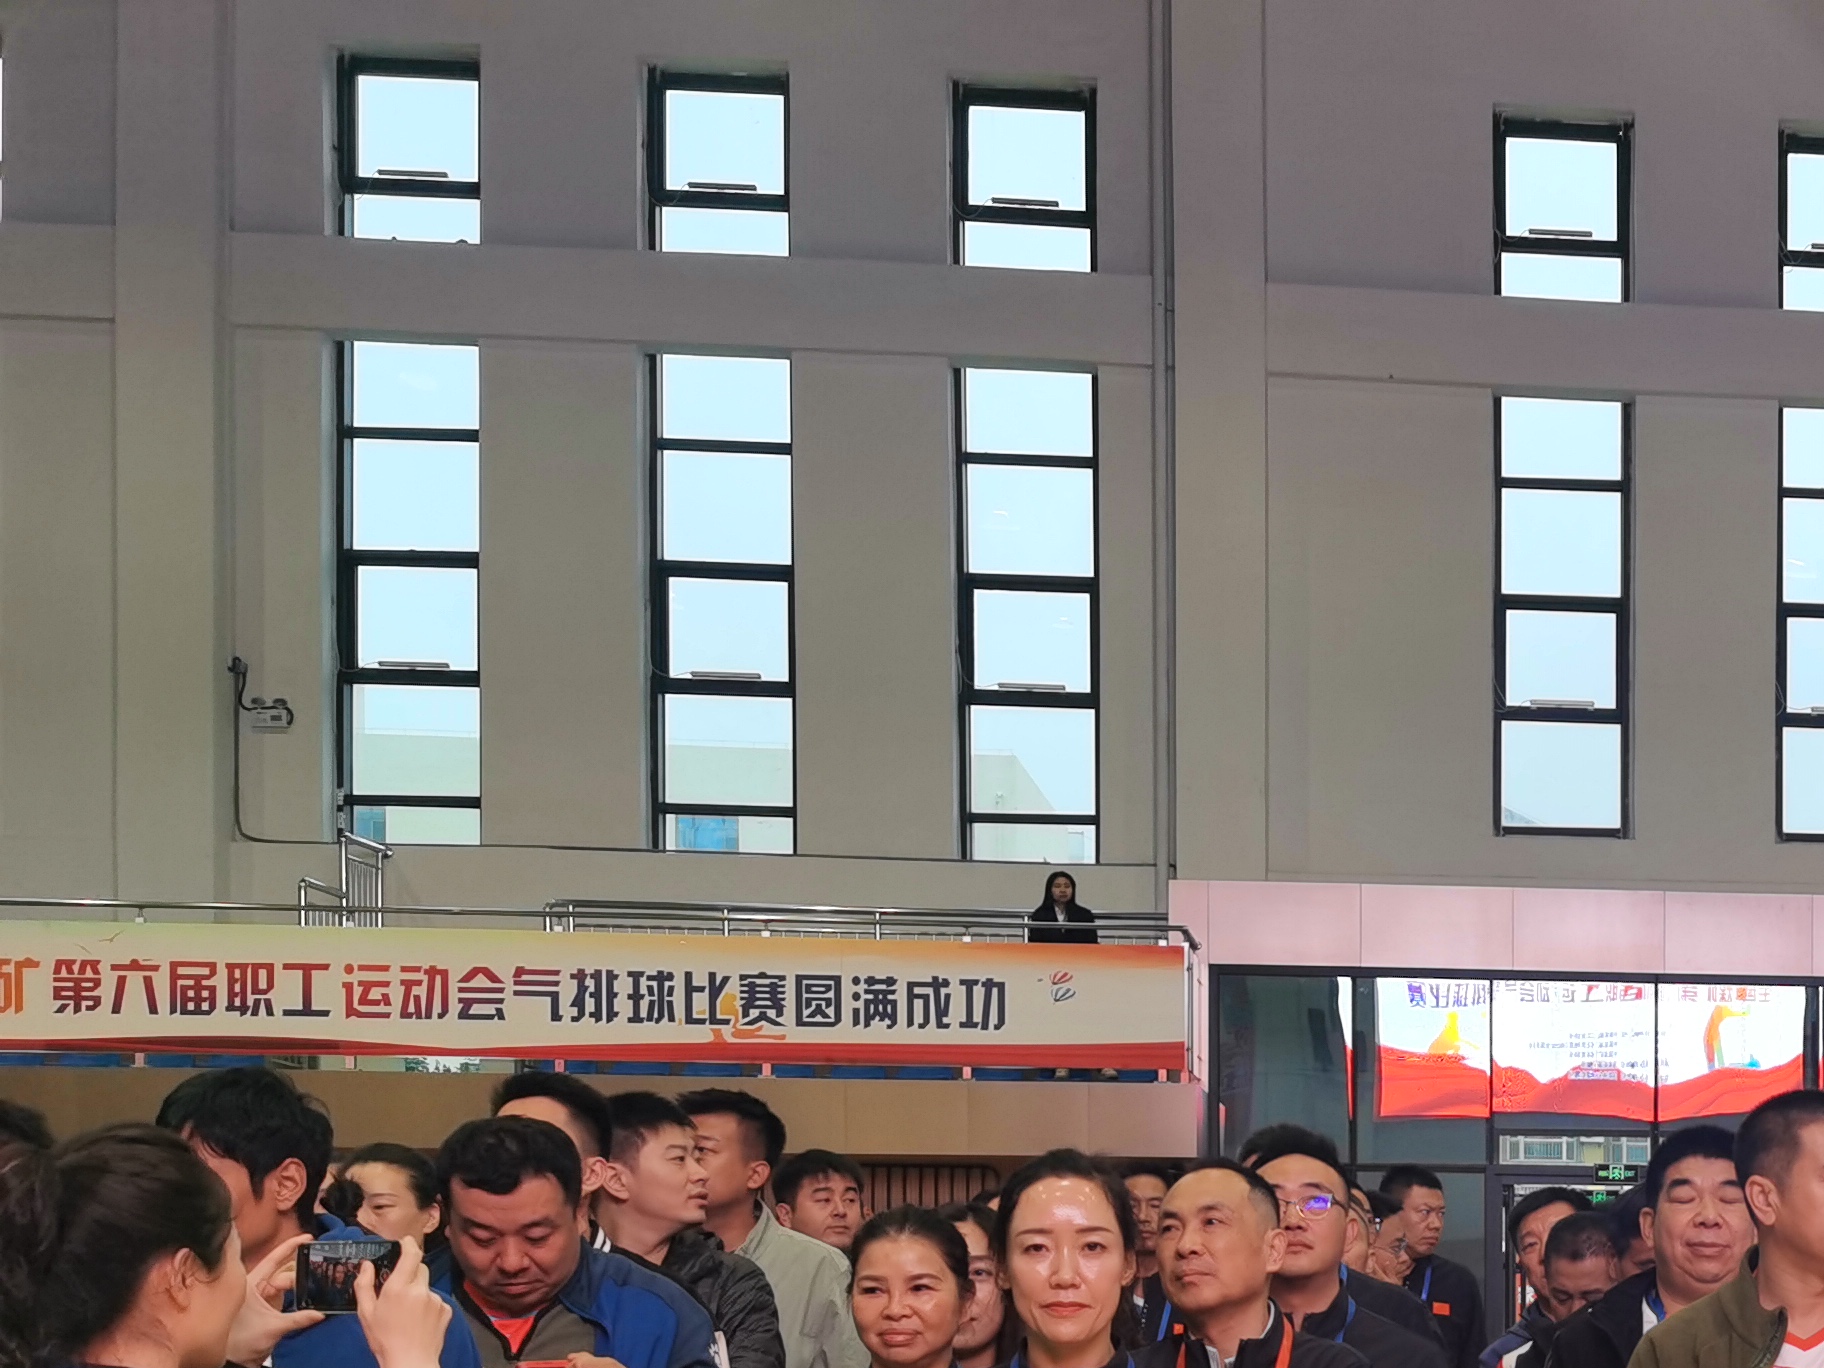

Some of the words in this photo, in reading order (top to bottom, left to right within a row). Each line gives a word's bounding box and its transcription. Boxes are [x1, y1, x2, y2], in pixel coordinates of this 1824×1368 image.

[0, 957, 1007, 1031] 矿第六届职工运动会气排球比赛圆满成功
